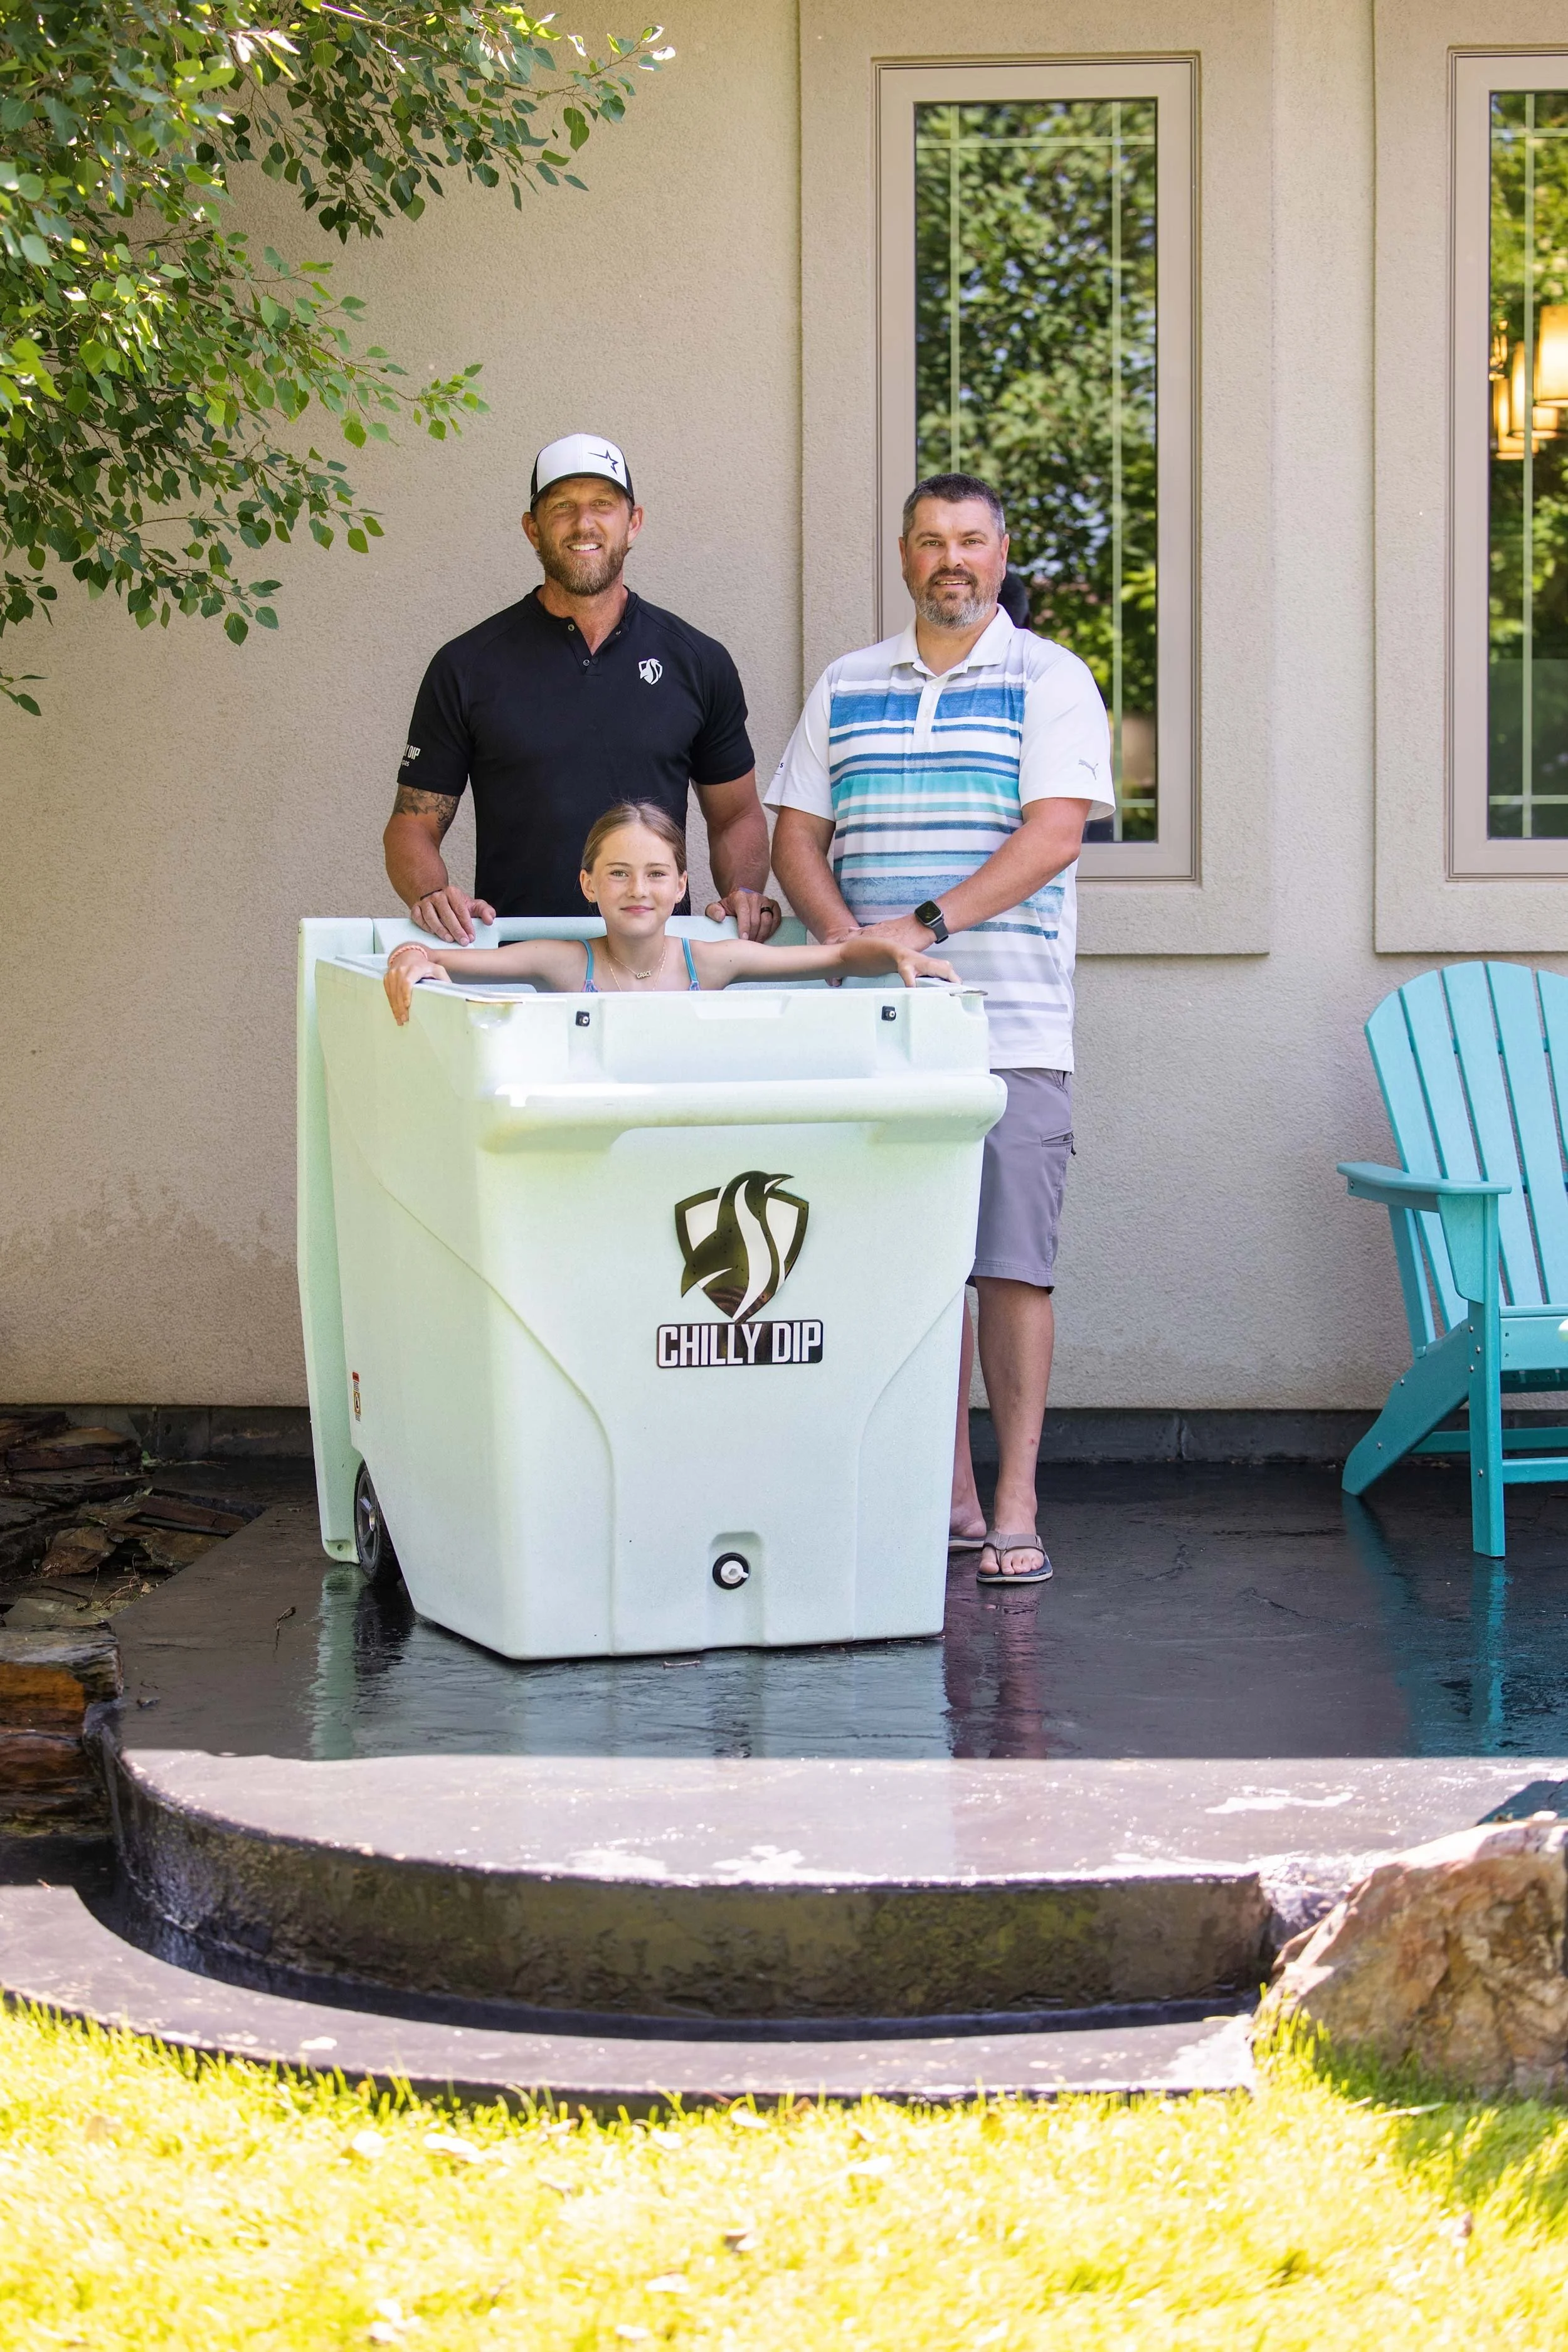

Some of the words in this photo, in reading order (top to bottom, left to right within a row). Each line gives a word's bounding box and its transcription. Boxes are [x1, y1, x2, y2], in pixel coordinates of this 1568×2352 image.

[408, 745, 421, 760] DIP
[659, 1323, 763, 1367] CHILLY
[771, 1322, 822, 1363] DIP
